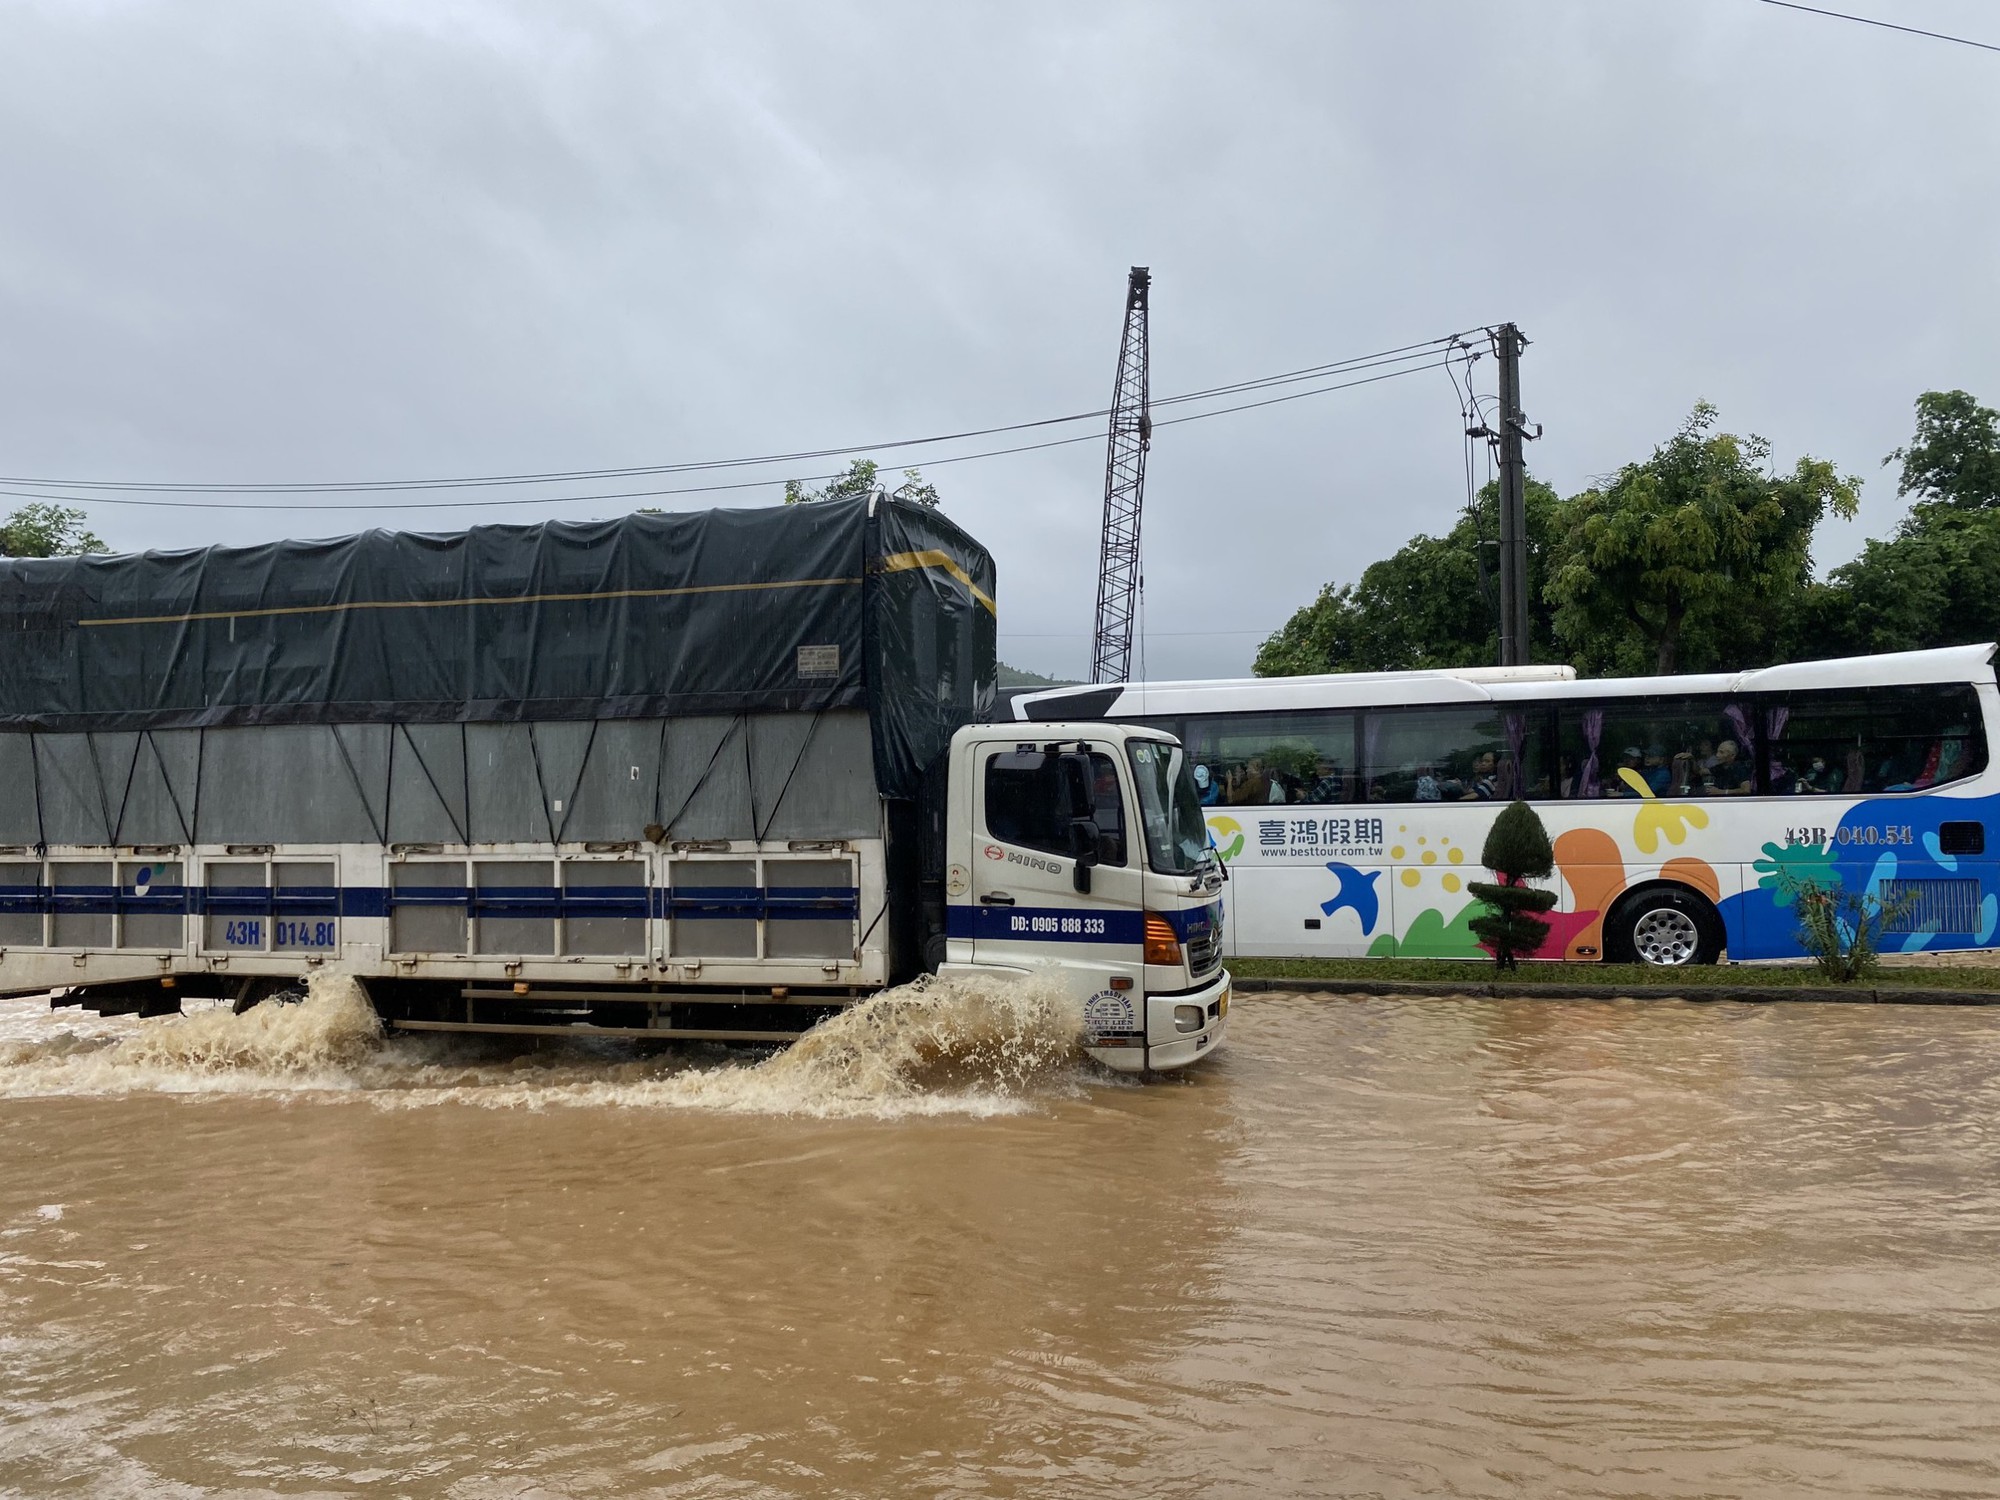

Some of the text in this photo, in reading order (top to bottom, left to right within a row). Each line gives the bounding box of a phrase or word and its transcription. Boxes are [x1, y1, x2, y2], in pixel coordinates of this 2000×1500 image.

[1259, 818, 1383, 845] 喜鴻假期
[1784, 825, 1913, 845] 43B-040.54
[1261, 846, 1383, 857] www.besttour.com.tw
[1007, 852, 1062, 875] HINO
[1031, 917, 1058, 932] 0905
[1061, 918, 1081, 933] 888
[1084, 919, 1105, 934] 333
